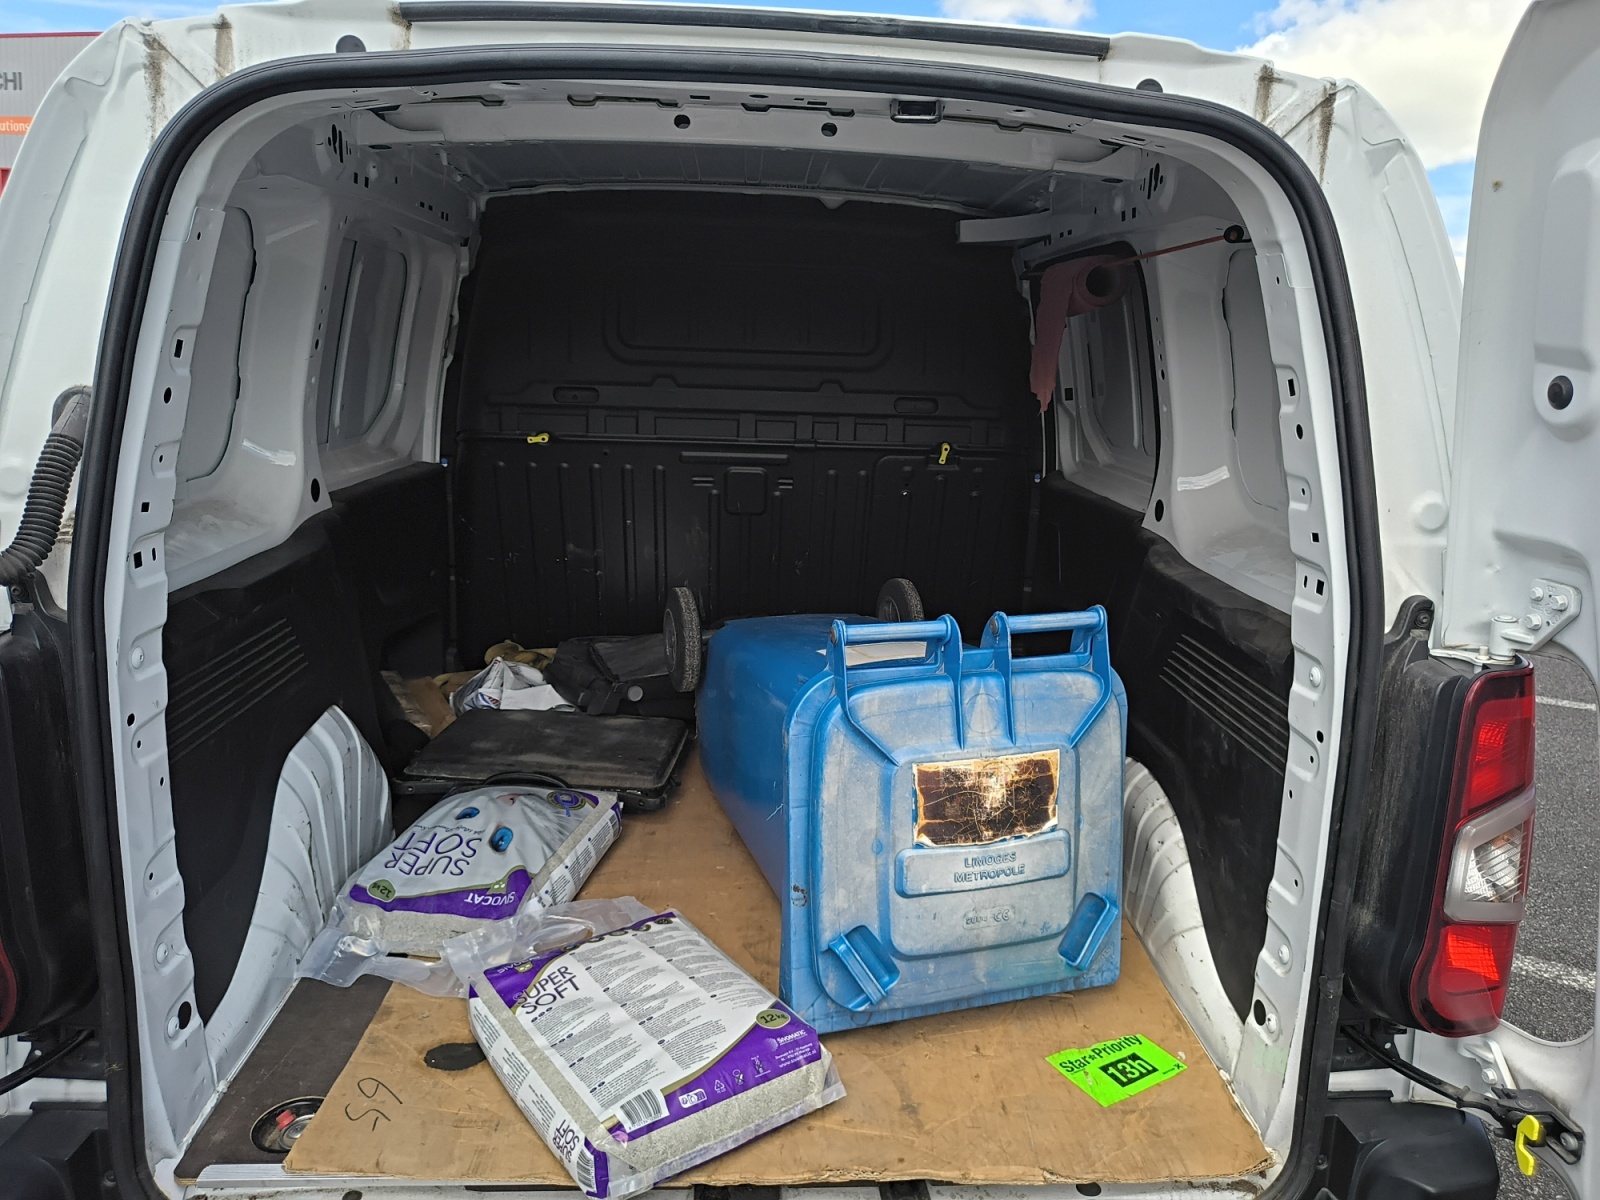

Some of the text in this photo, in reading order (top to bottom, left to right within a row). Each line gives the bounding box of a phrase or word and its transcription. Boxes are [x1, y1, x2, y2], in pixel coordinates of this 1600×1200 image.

[394, 833, 482, 858] SOFT
[384, 851, 470, 876] SUPER
[964, 852, 1017, 869] LIMOGES
[954, 864, 1025, 883] METROPOLE
[464, 891, 516, 906] SIVOCAT
[512, 966, 574, 1006] SUPER
[521, 975, 580, 1015] SOFT
[1107, 1059, 1153, 1083] 13h
[556, 1119, 580, 1151] SOFT
